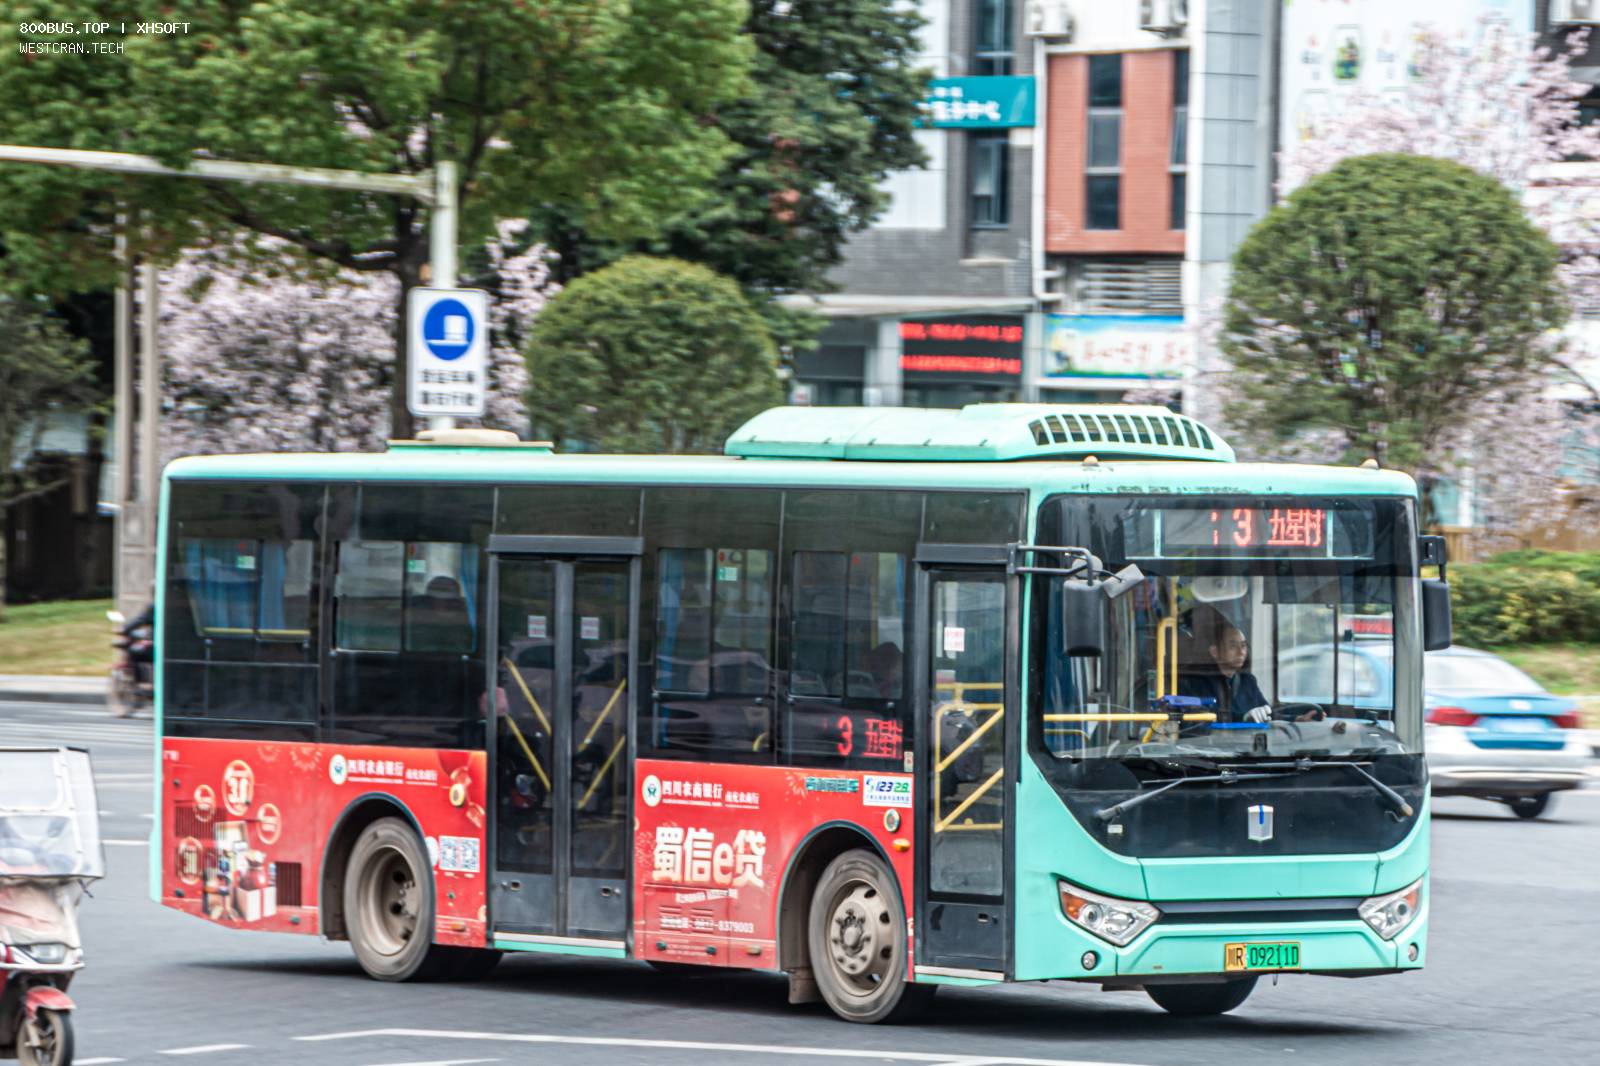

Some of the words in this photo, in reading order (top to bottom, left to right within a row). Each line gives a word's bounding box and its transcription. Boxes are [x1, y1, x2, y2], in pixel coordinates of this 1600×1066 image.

[662, 780, 724, 799] 四川农商银行
[652, 826, 767, 889] 蜀信e贷
